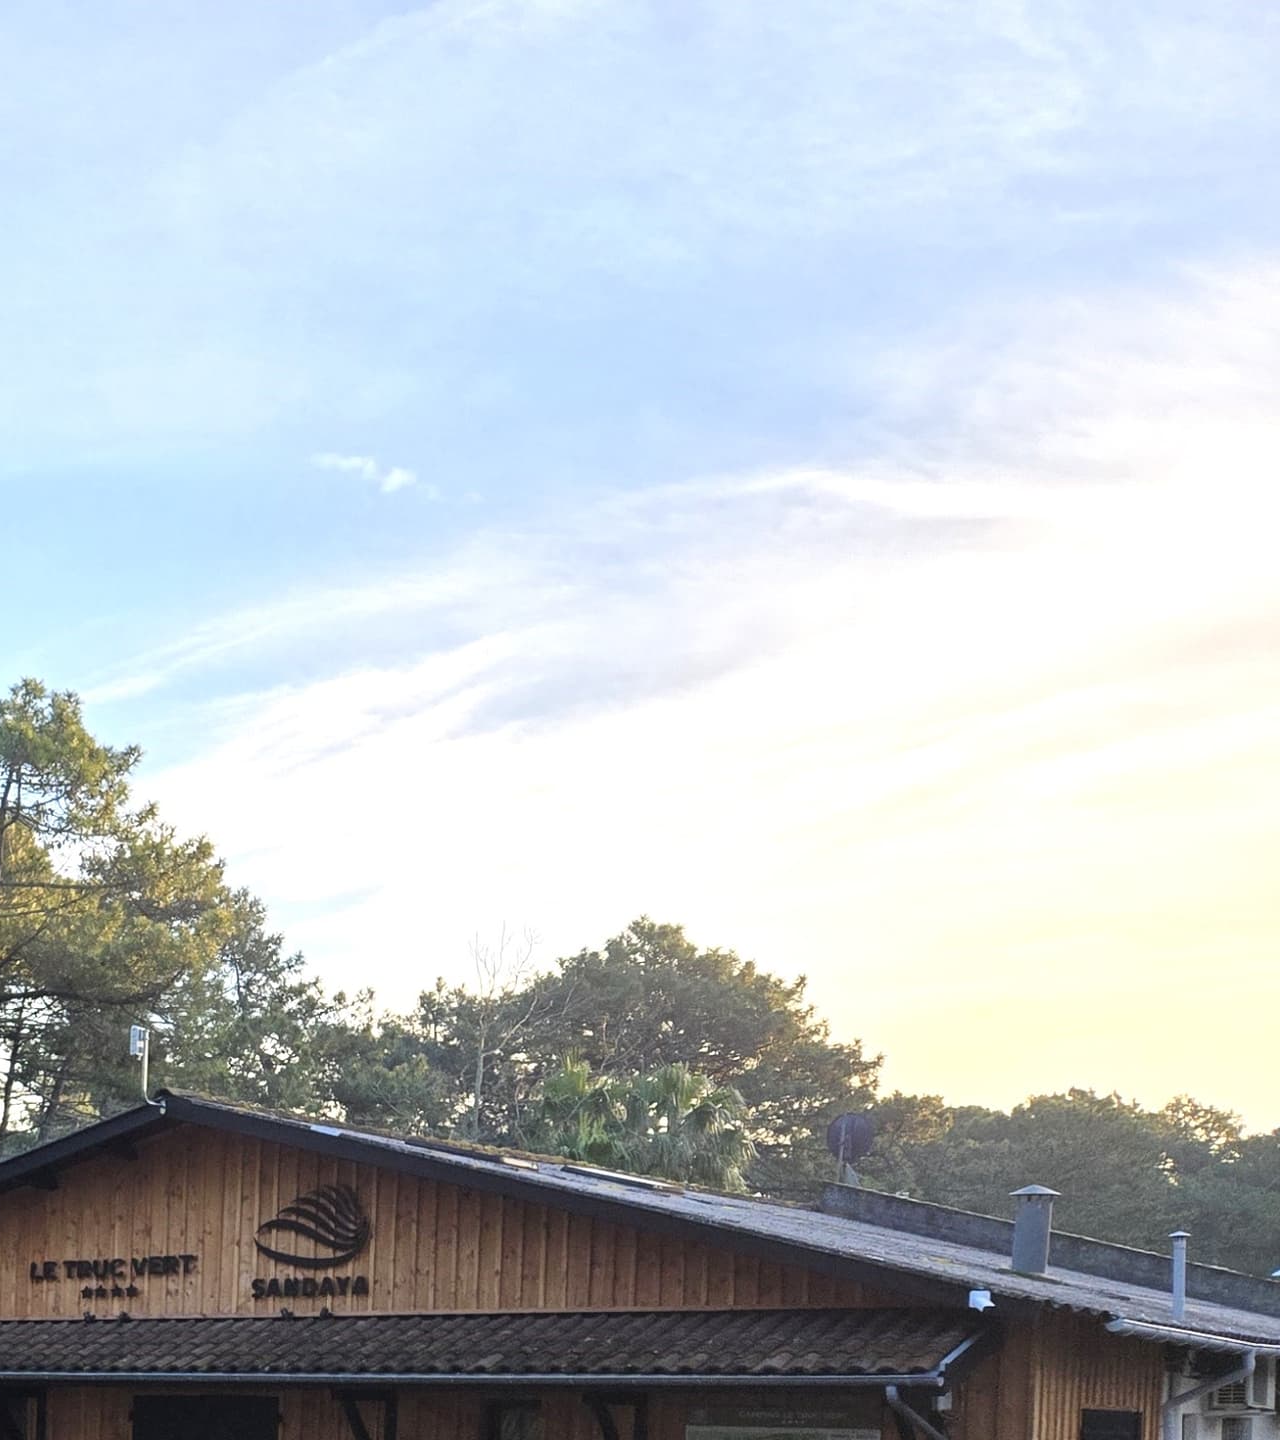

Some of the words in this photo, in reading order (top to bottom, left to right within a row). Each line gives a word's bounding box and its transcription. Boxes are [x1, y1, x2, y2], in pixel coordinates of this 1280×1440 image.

[30, 1261, 58, 1281] LE
[63, 1259, 127, 1279] TRUC
[131, 1254, 197, 1275] VERT
[251, 1275, 370, 1299] SANDAYA
